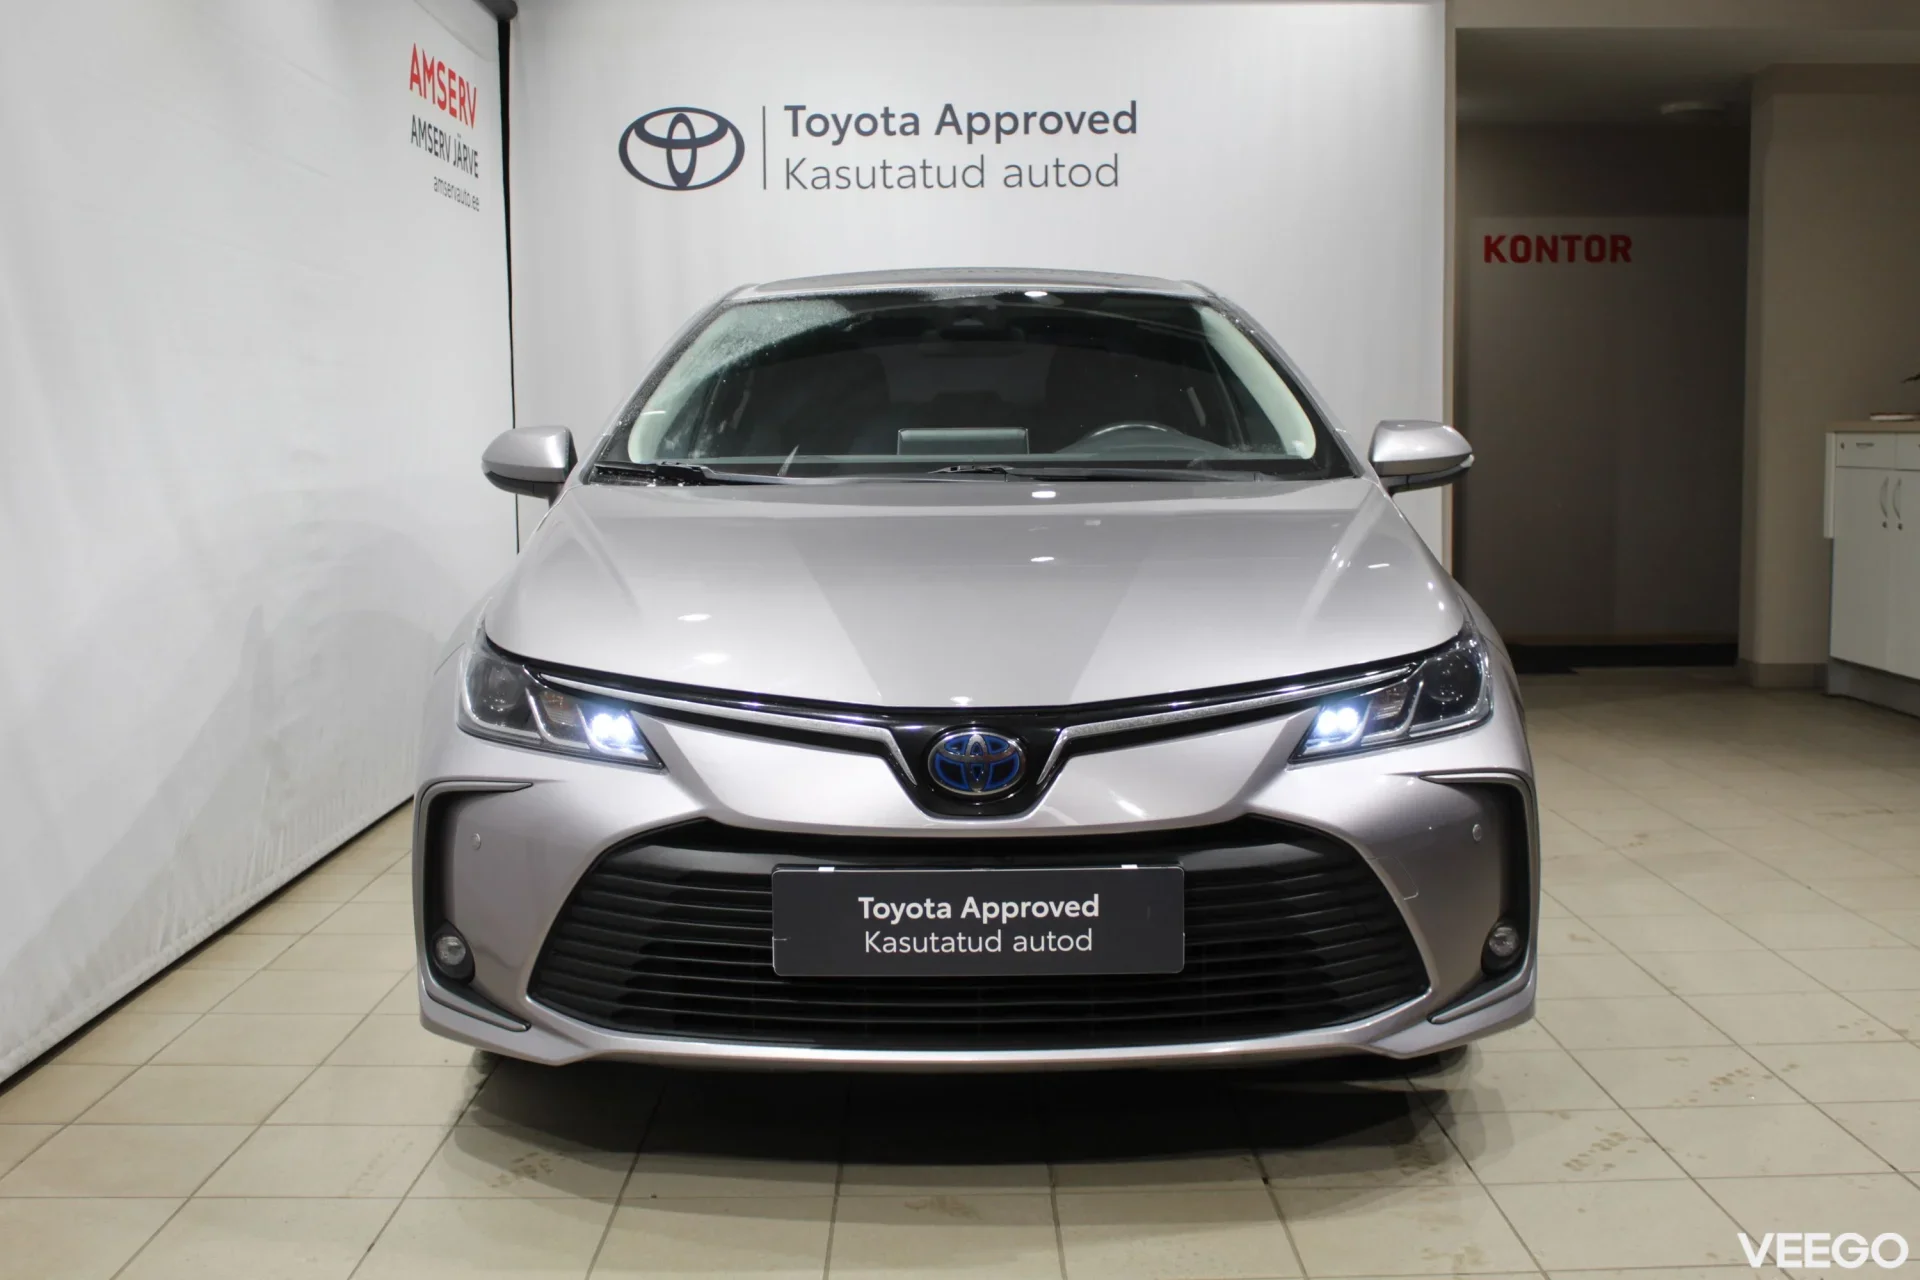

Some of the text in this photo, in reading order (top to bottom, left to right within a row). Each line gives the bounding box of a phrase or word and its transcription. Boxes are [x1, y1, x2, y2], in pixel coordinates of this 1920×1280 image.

[409, 42, 477, 130] AMSERV
[784, 100, 1138, 145] Toyota Approved
[410, 114, 479, 178] AMSERV JÄRVE
[785, 153, 1120, 191] Kasutatud autod
[1483, 234, 1633, 264] KONTOR
[858, 894, 1100, 925] Toyota Approved
[865, 928, 1093, 954] Kasutatud autod
